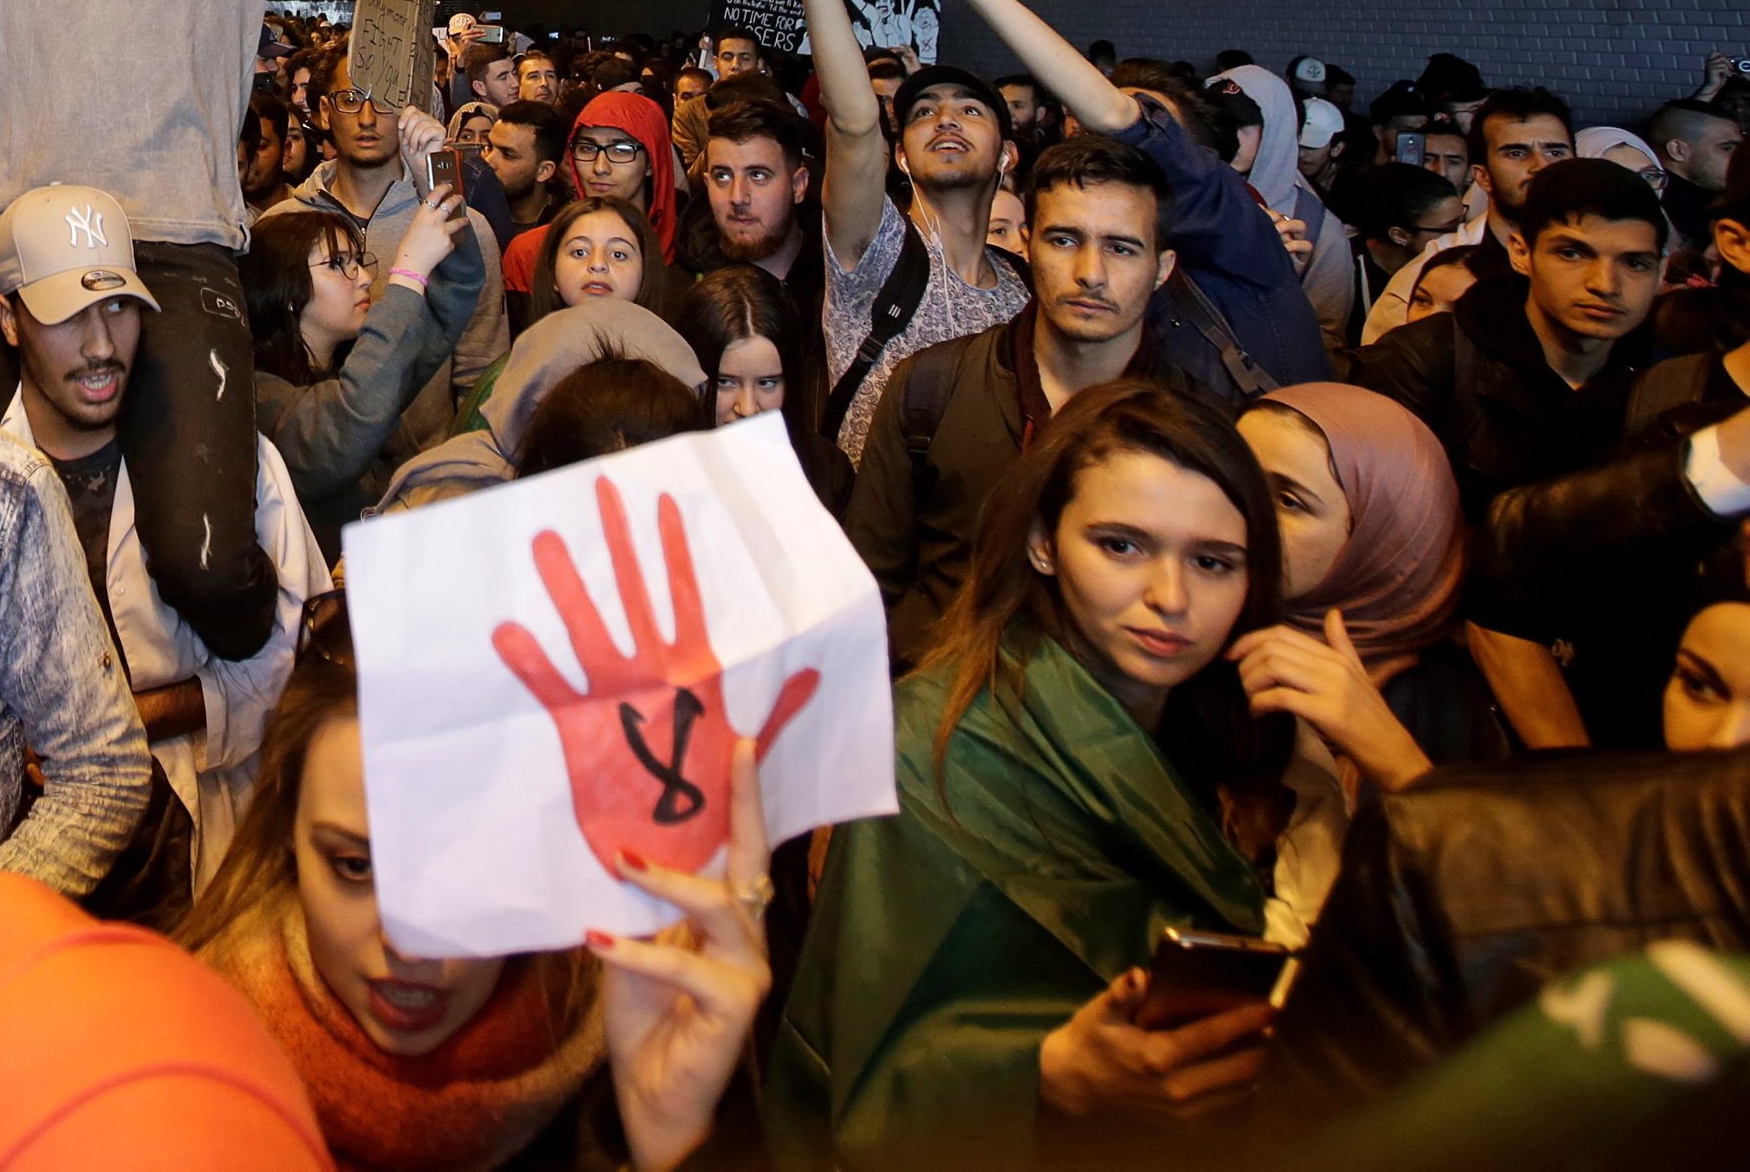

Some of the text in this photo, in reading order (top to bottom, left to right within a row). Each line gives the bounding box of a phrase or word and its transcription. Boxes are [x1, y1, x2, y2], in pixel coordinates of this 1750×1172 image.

[723, 6, 795, 31] NO TIME FOR
[64, 204, 109, 248] NY
[618, 688, 706, 824] لا
